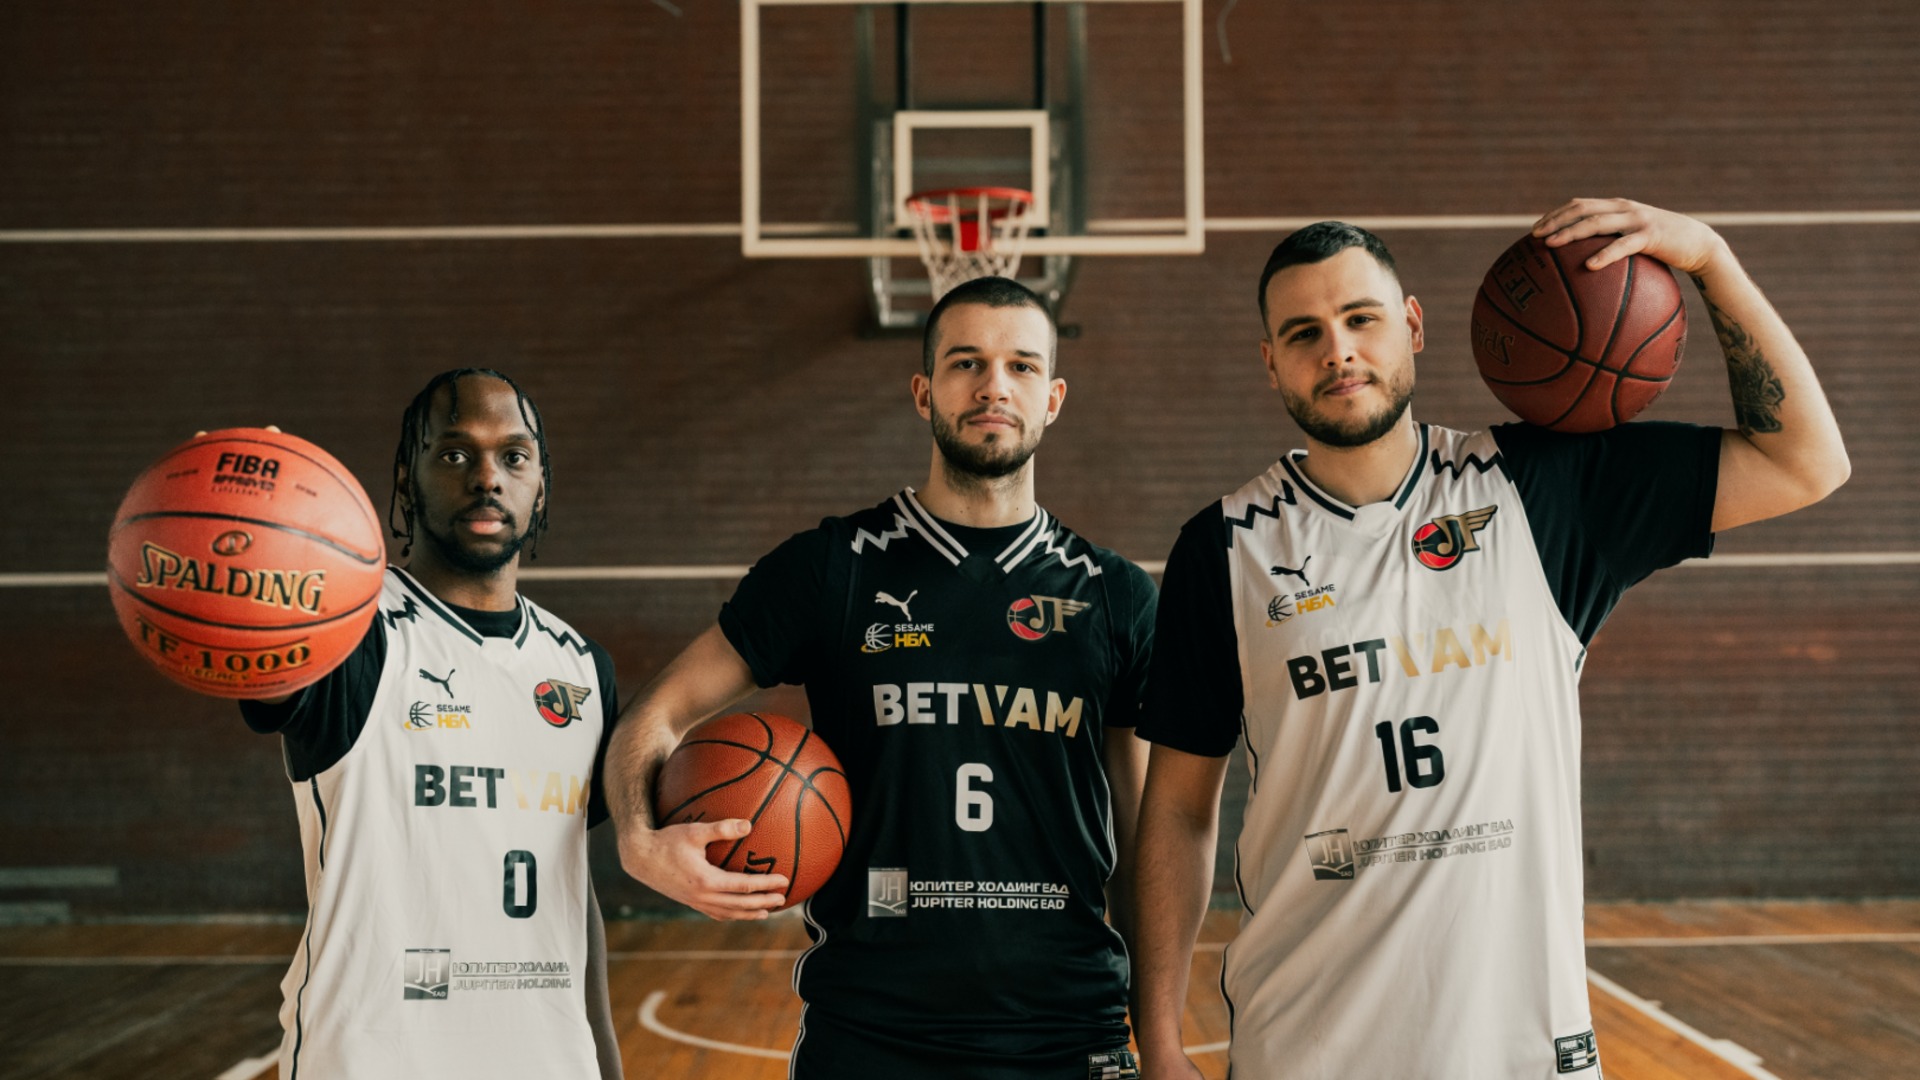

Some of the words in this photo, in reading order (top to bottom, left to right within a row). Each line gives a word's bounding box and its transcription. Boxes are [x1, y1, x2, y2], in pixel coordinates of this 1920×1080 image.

[216, 453, 280, 479] FIBA
[213, 474, 276, 491] APPROVED
[137, 541, 326, 616] SPALDING
[1294, 584, 1336, 600] SESAME
[894, 624, 935, 633] SESAME
[1286, 617, 1513, 700] BETVAM
[436, 704, 471, 713] SESAME
[873, 682, 1084, 738] BETVAM
[1375, 716, 1445, 793] 16
[955, 762, 994, 832] 6
[1321, 839, 1346, 864] JH
[1358, 850, 1417, 868] JUPITER
[1419, 840, 1486, 861] HOLDING
[1488, 837, 1512, 850] EAD
[503, 850, 537, 918] 0
[878, 877, 901, 901] JH
[910, 881, 975, 892] ЮПИТЕР
[977, 881, 1041, 893] ХОЛДИНГ
[1042, 883, 1069, 894] ЕАД
[911, 897, 974, 909] JUPITER
[977, 897, 1039, 910] HOLDING
[1041, 899, 1065, 910] EAD
[414, 957, 442, 984] JH
[453, 962, 517, 974] ЮПИТЕР
[453, 979, 515, 991] JUPITER
[517, 978, 571, 989] HOLDING
